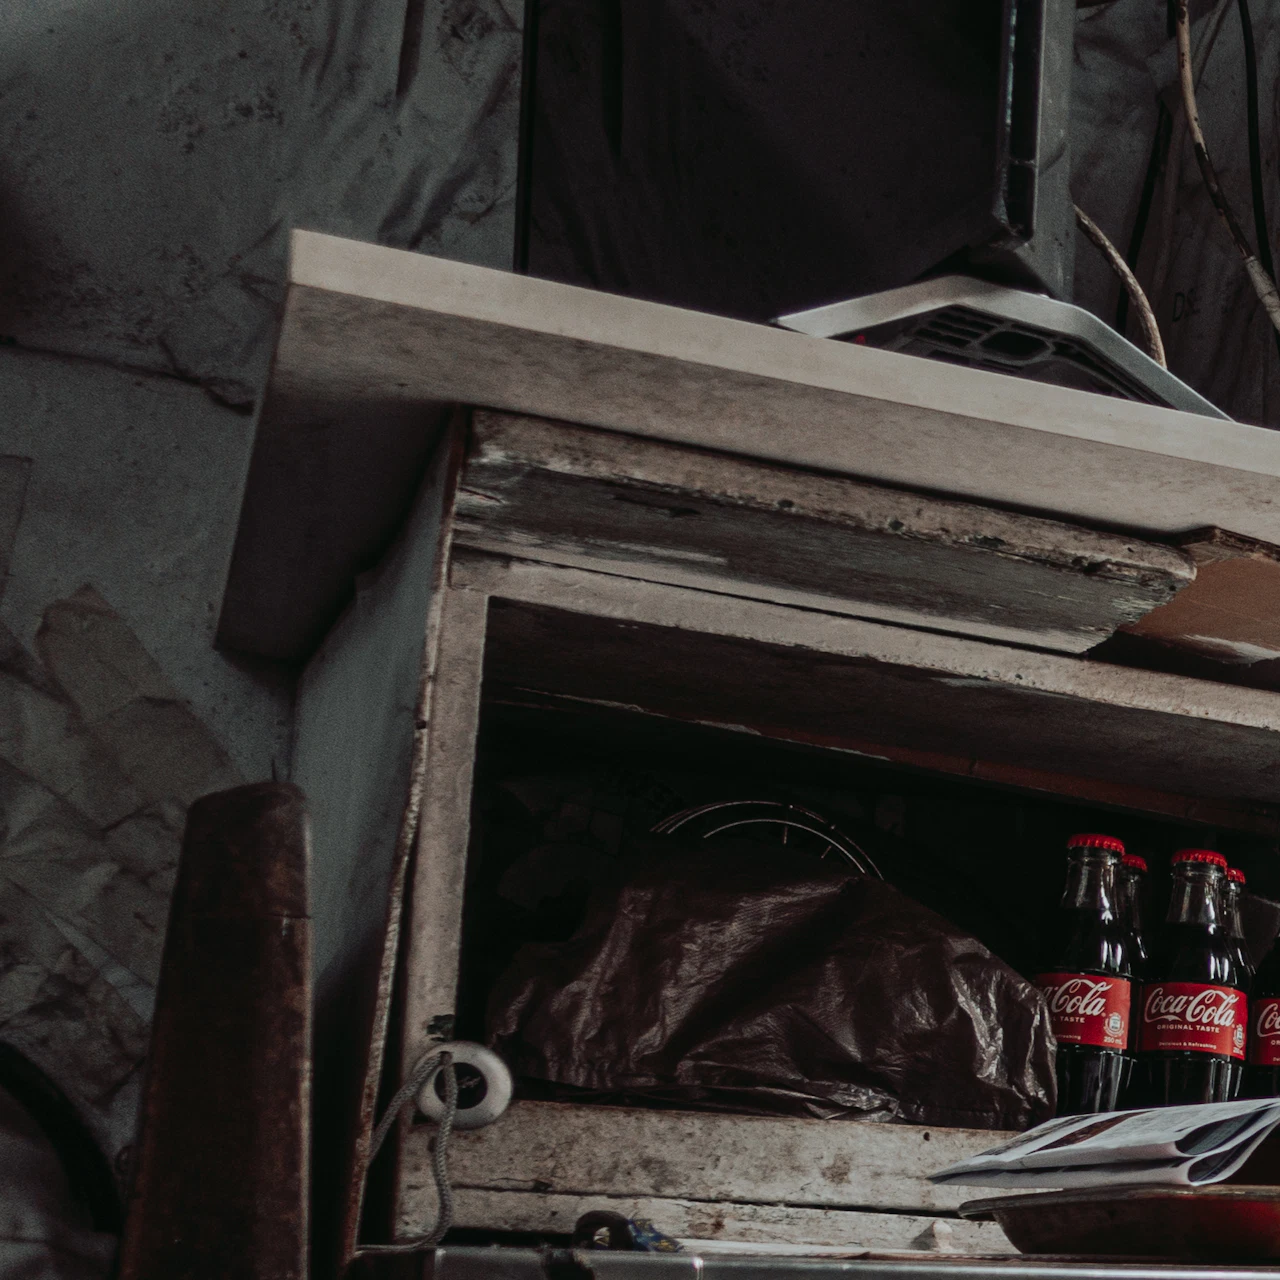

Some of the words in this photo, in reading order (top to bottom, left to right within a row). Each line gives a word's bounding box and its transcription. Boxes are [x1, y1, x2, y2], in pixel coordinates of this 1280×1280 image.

[1059, 1015, 1086, 1024] TASTE
[1156, 1024, 1193, 1032] ORIGINAL
[1195, 1026, 1221, 1035] TASTE
